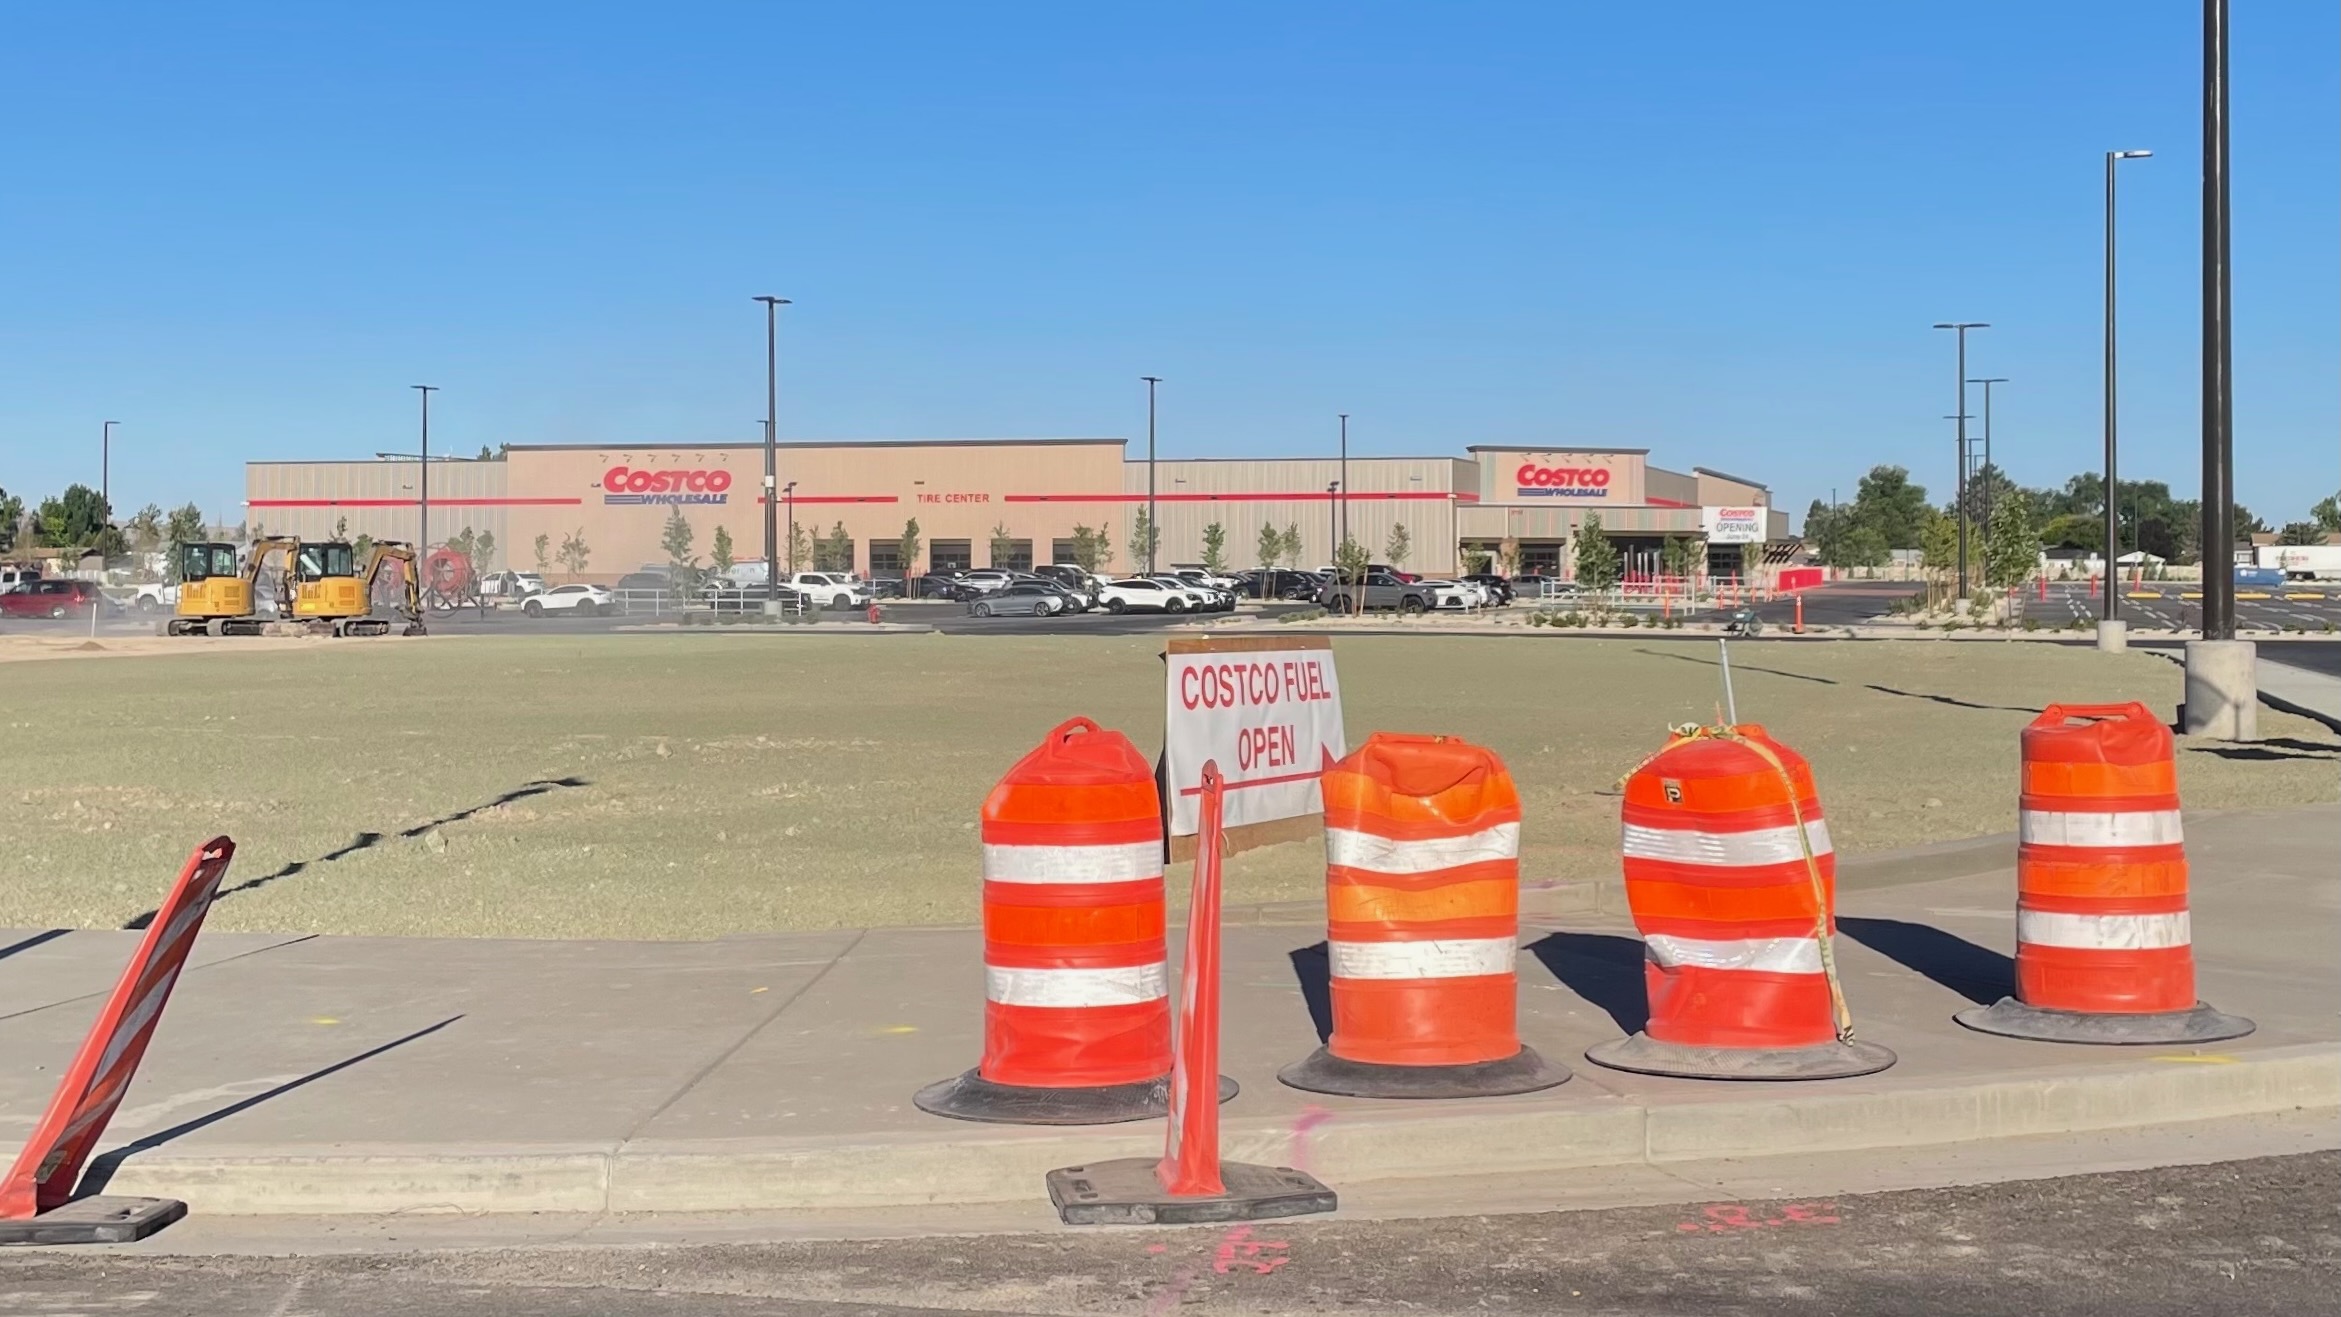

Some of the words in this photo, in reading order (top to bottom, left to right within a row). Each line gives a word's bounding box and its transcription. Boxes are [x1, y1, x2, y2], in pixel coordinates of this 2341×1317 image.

[603, 466, 732, 493] COSTCO
[1517, 464, 1610, 487] COSTCO
[641, 494, 728, 504] WHOLESALE
[917, 494, 941, 503] TIRE
[945, 493, 990, 503] CENTER
[1545, 488, 1608, 497] WHOLESALE
[1716, 522, 1758, 532] OPENING
[1181, 662, 1280, 711] COSTCO
[1283, 661, 1332, 702] FUEL
[1238, 724, 1296, 772] OPEN
